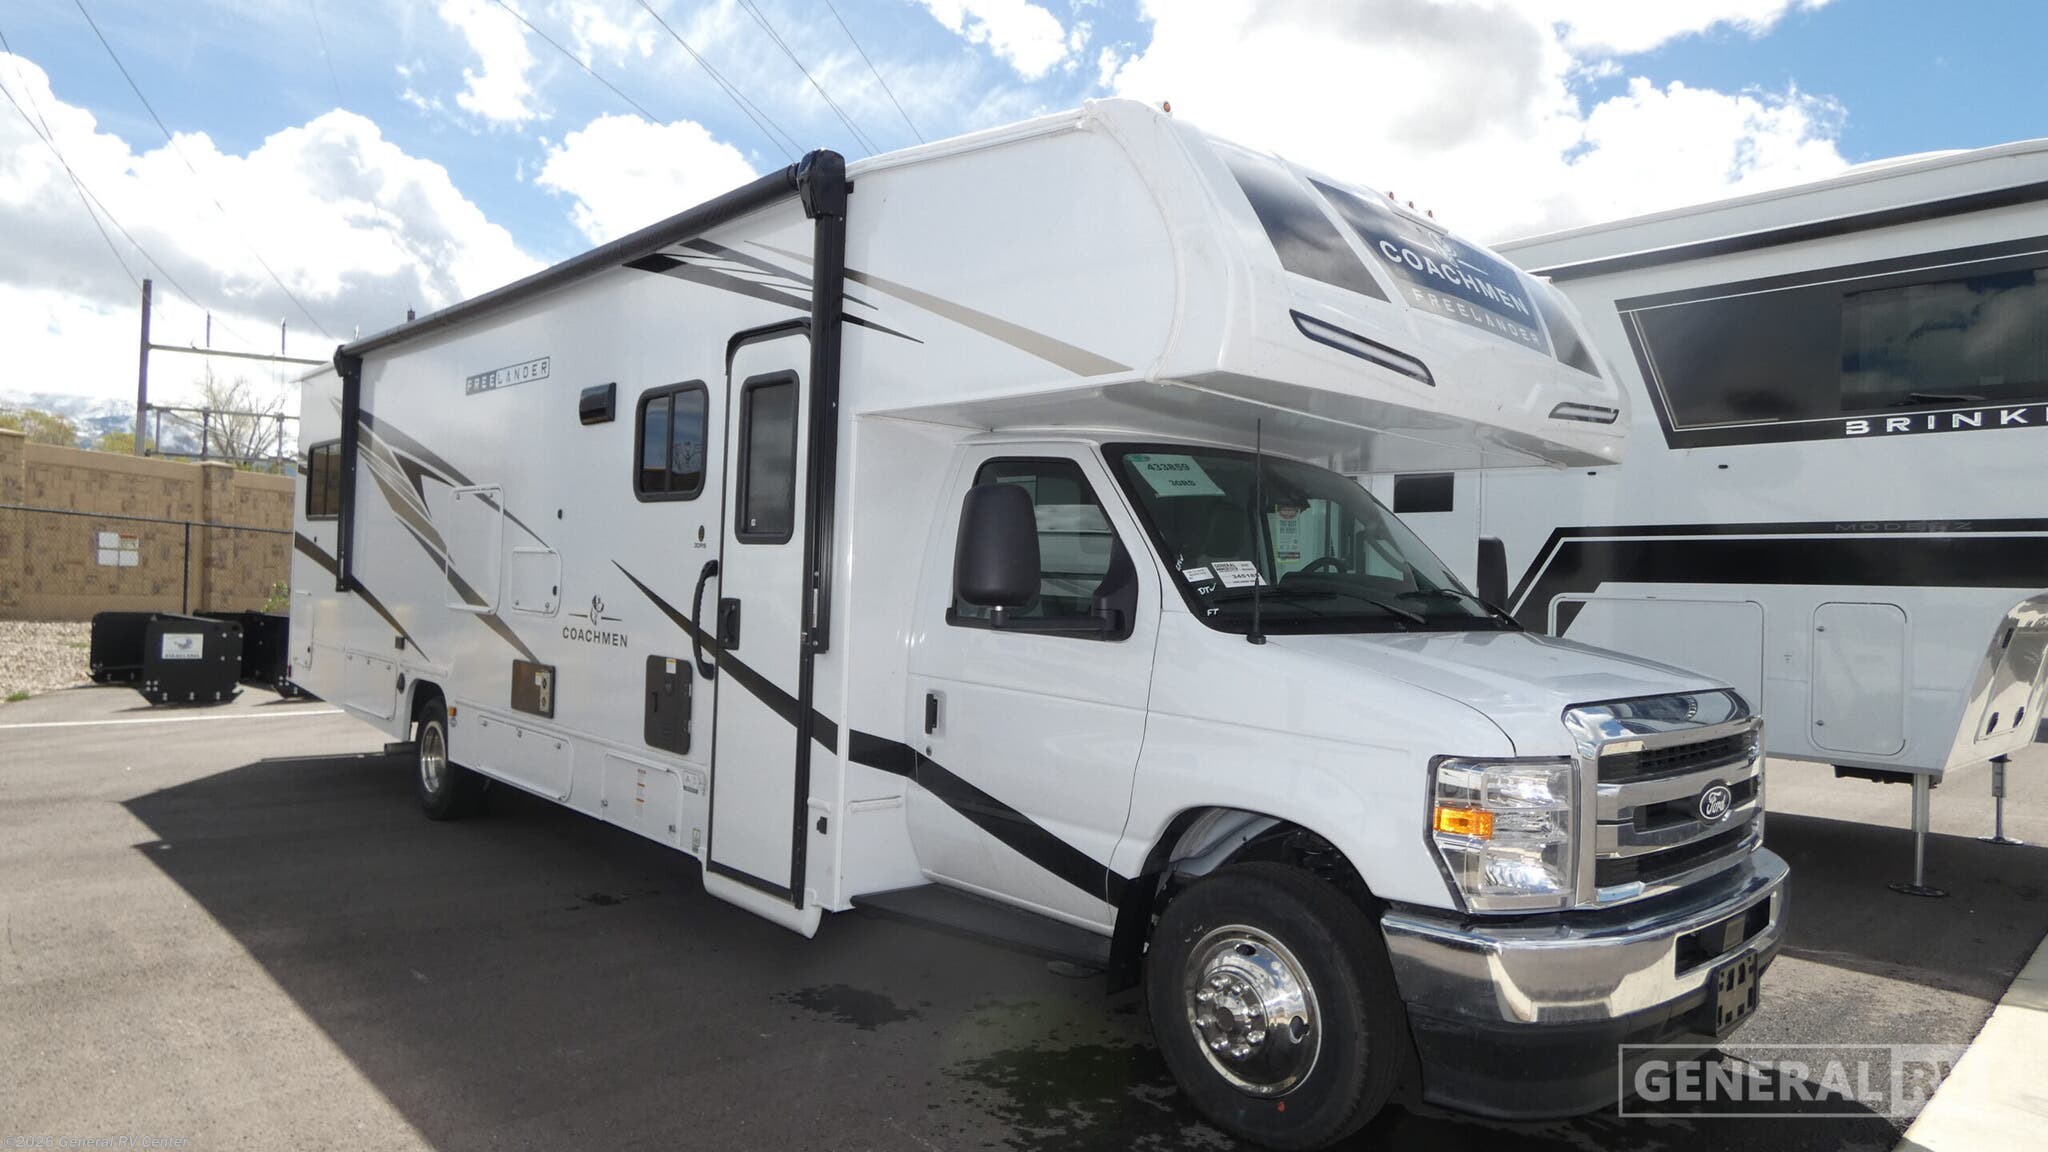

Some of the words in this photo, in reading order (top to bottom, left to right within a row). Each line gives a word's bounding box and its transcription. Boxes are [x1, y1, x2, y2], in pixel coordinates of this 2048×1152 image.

[1379, 240, 1530, 316] COACHMEN
[1411, 287, 1541, 345] FREELANDER
[466, 361, 548, 389] FREELANDER
[562, 626, 628, 647] COACHMEN
[1706, 791, 1726, 815] Ford
